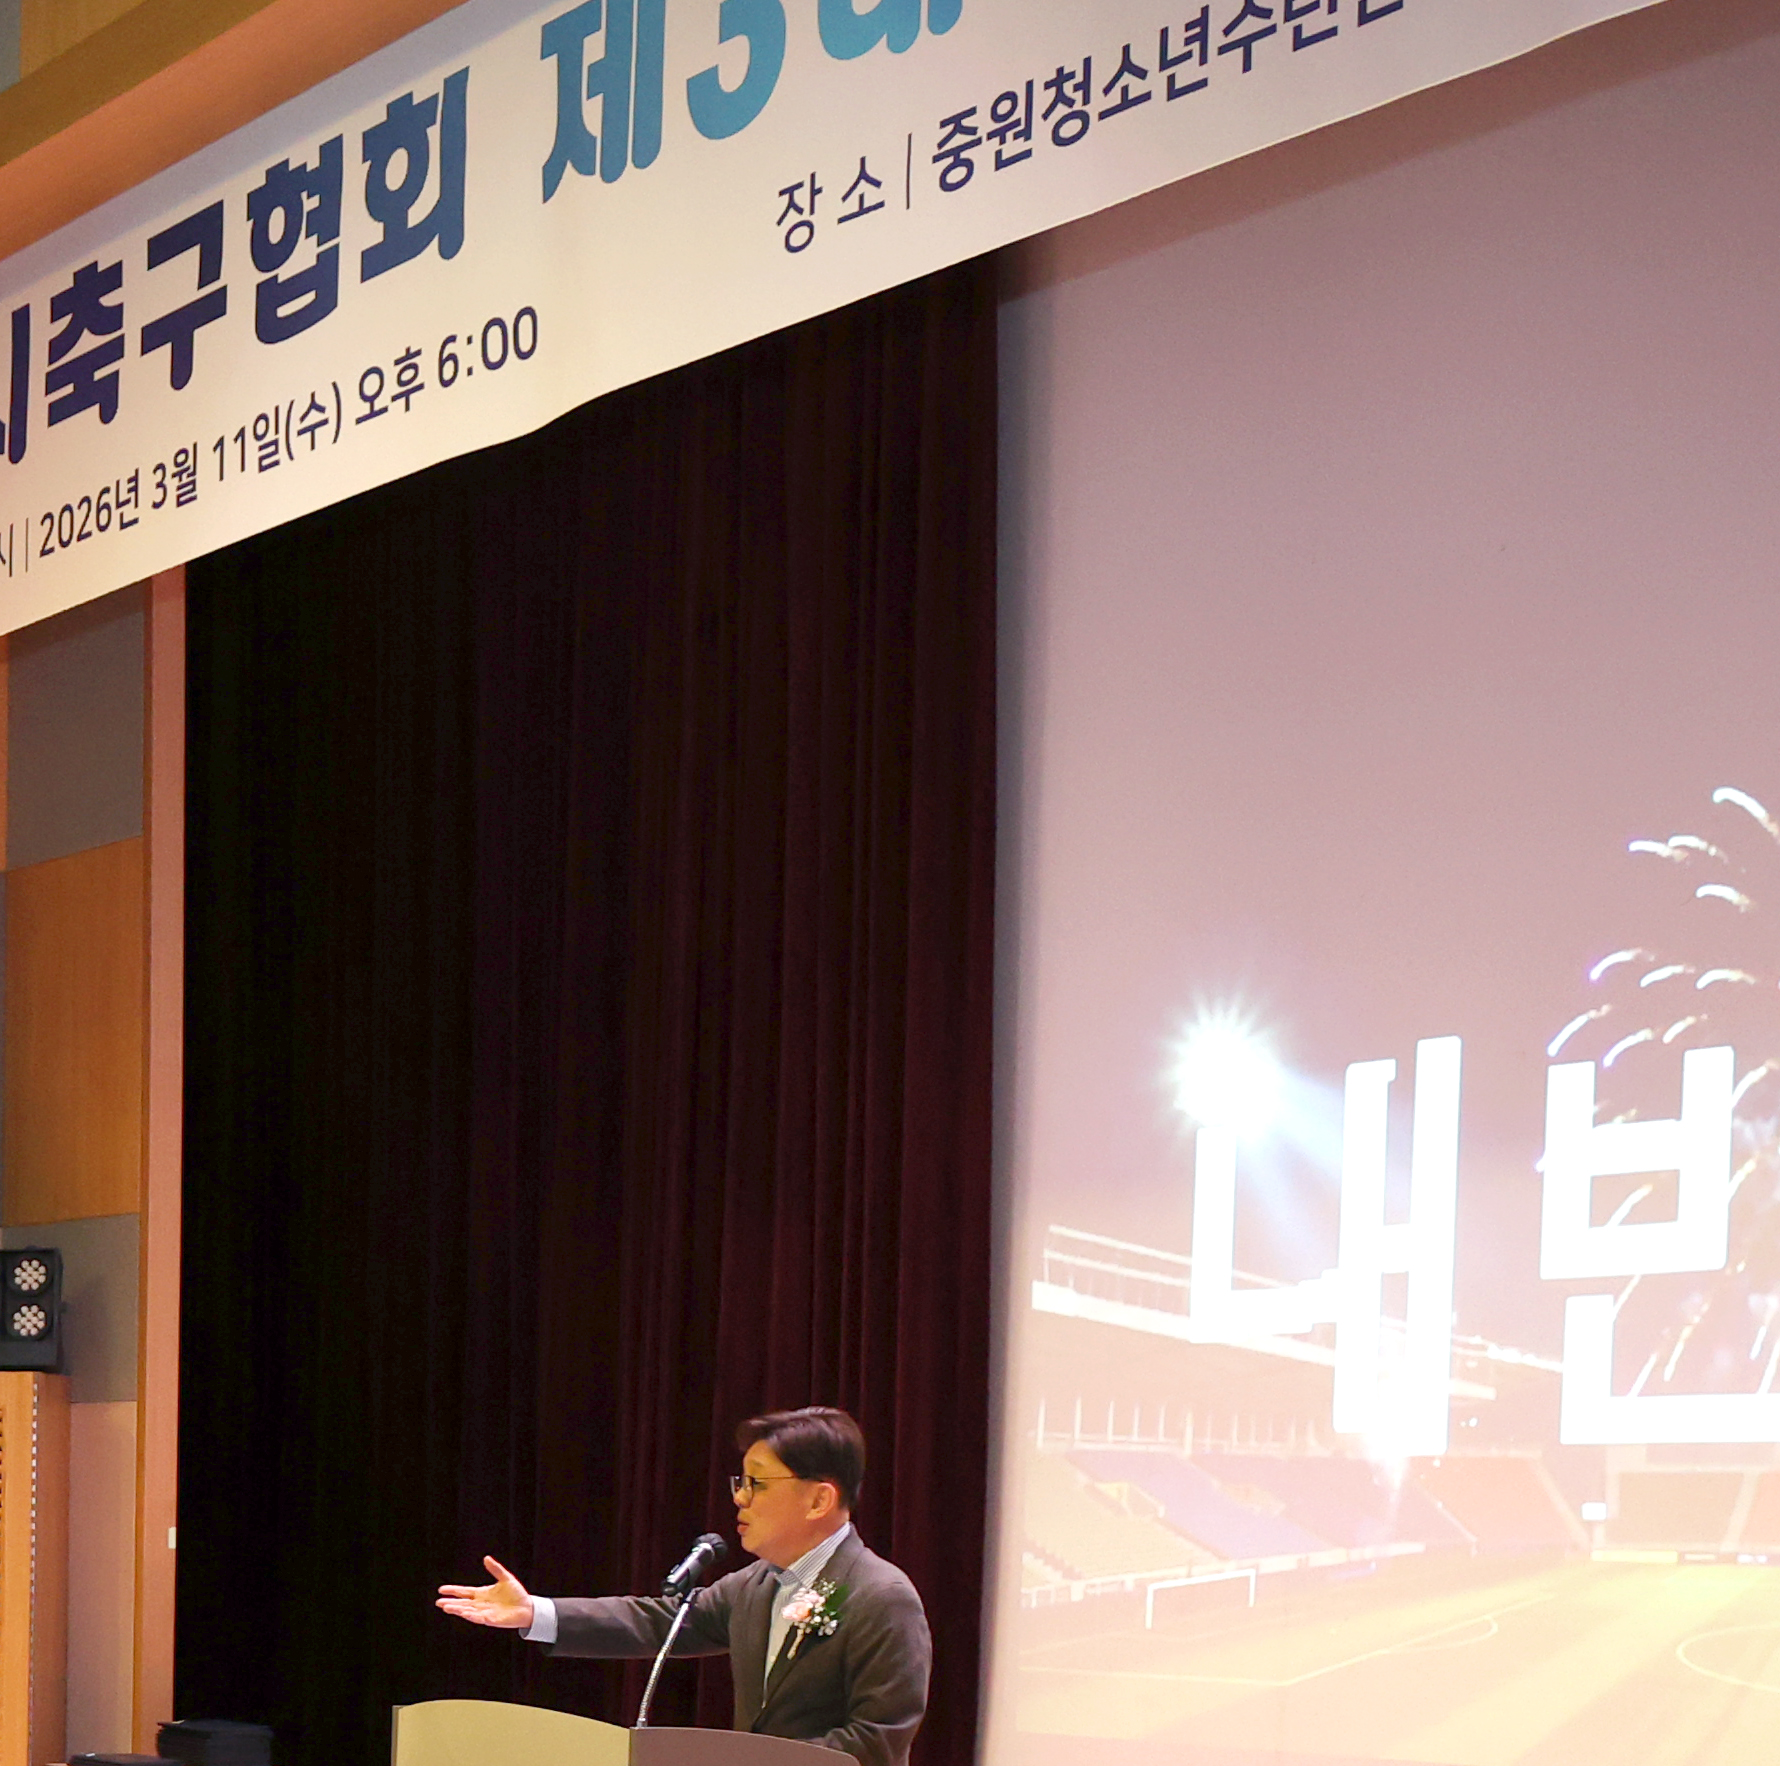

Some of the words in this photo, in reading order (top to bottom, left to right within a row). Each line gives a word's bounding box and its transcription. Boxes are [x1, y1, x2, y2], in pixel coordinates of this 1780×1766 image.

[932, 0, 1405, 192] 중원청소년수
[39, 467, 139, 558] 2026년
[151, 441, 198, 510] 3월
[212, 381, 342, 482] 11일(수)
[355, 346, 425, 425] 오후
[438, 306, 538, 388] 6:00
